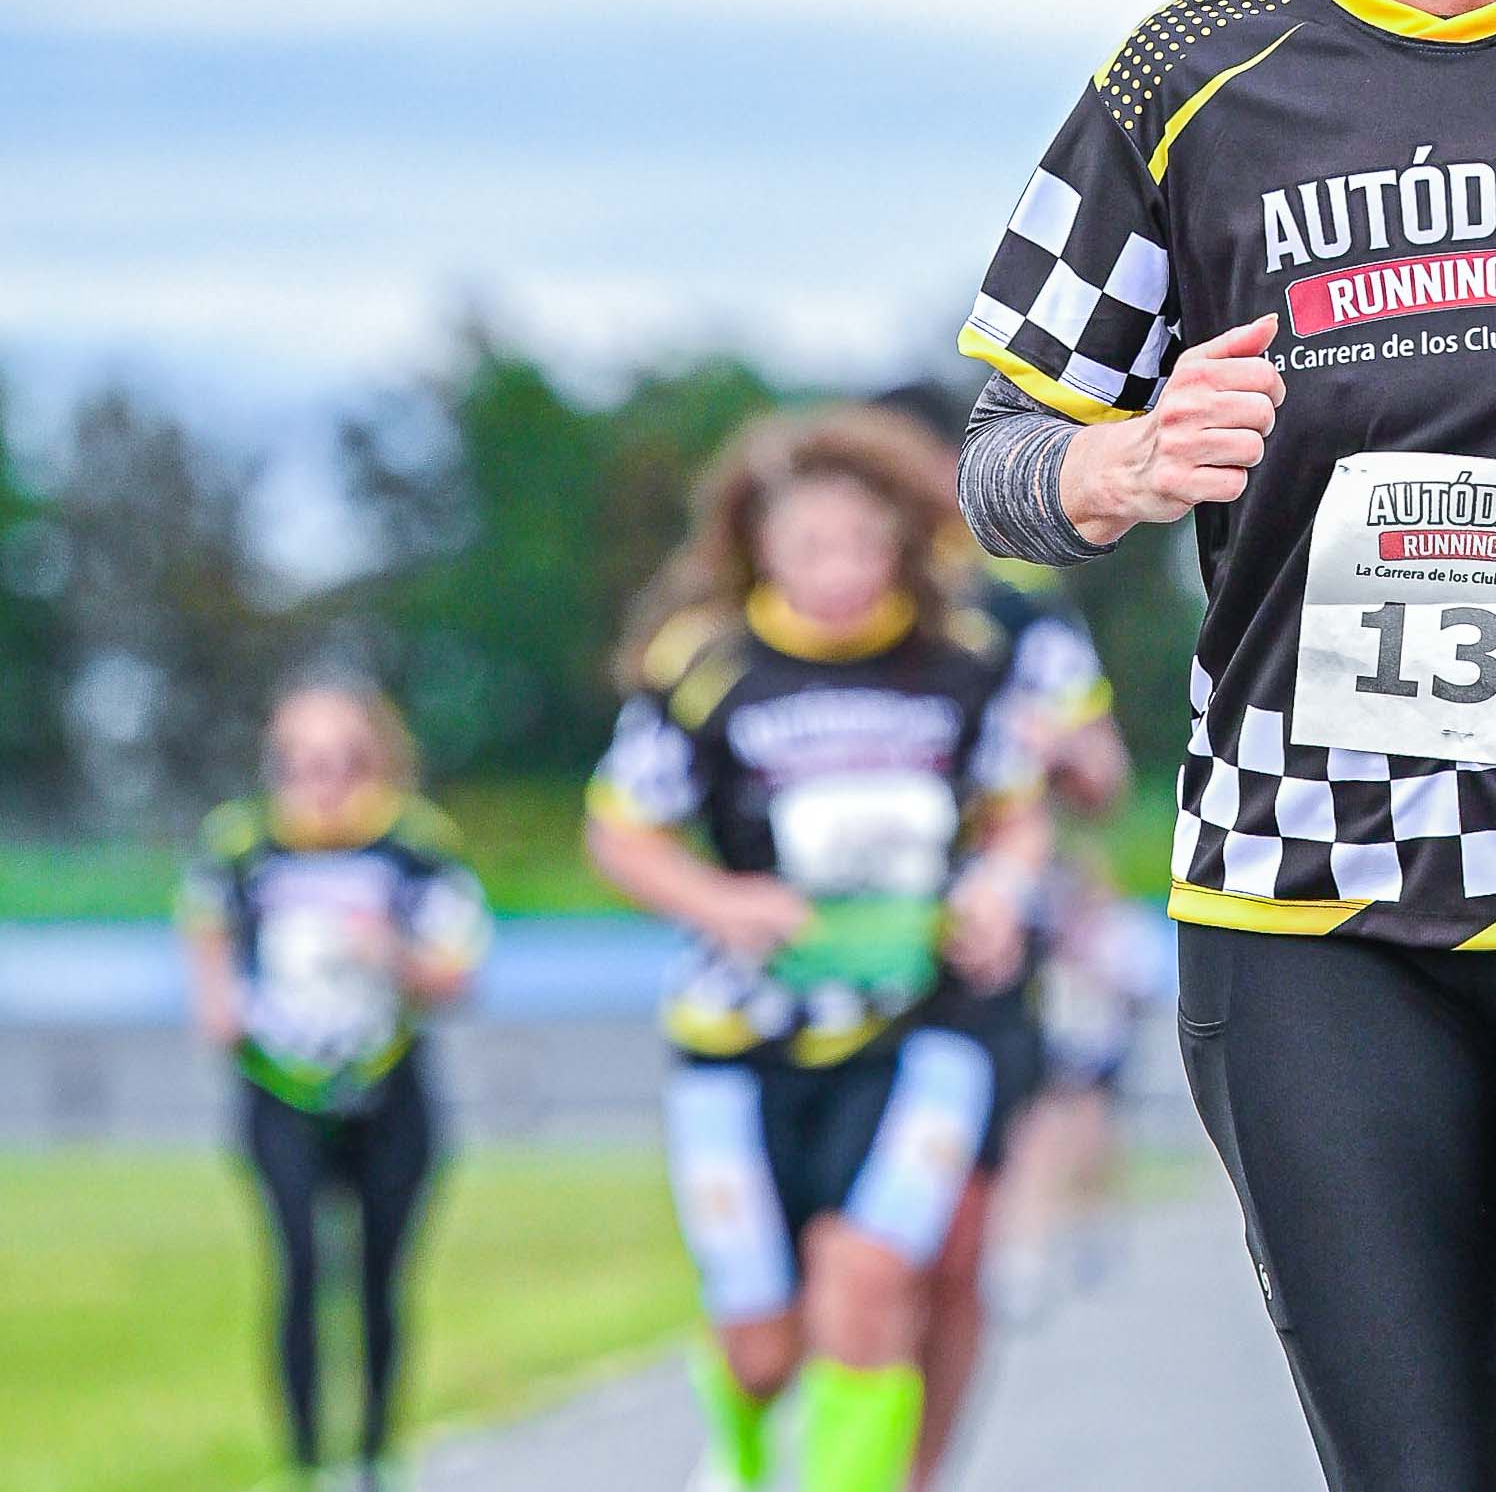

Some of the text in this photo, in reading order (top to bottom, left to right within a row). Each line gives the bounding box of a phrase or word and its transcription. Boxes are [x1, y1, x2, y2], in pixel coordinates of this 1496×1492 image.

[1290, 342, 1375, 370] Carrera
[1381, 333, 1414, 358] de
[1421, 330, 1458, 355] los
[1355, 563, 1371, 577] La
[1374, 565, 1425, 581] Carrera
[1428, 568, 1446, 583] de
[1449, 570, 1468, 584] los
